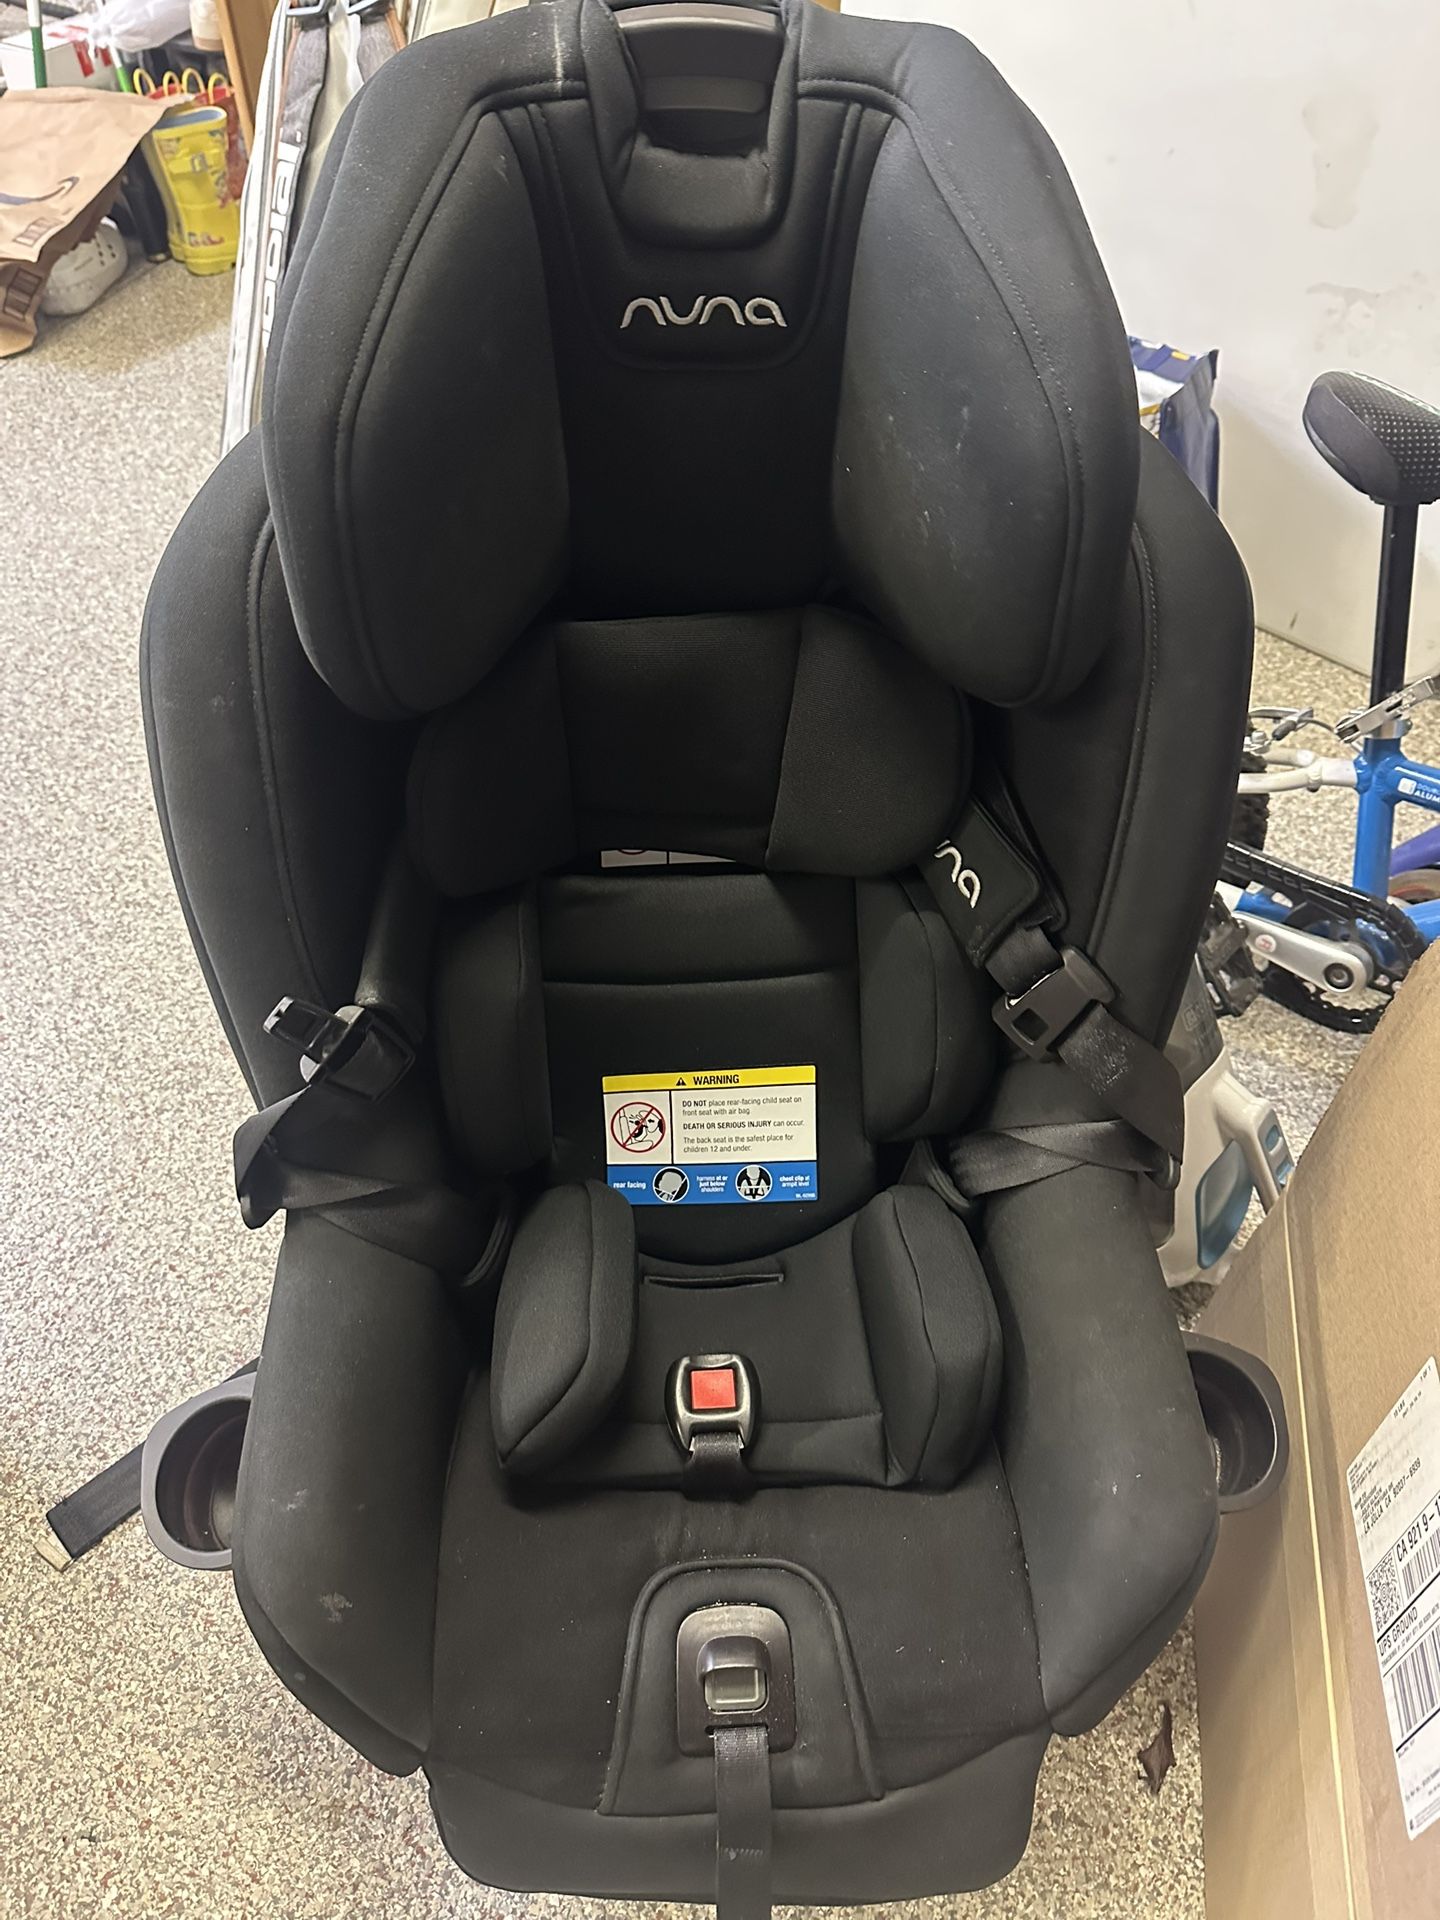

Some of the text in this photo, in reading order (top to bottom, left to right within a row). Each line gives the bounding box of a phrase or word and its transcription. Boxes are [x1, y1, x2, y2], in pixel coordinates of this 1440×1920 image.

[620, 296, 788, 328] nuna
[693, 1074, 739, 1085] WARNING
[694, 1099, 706, 1107] NOT
[727, 1098, 761, 1106] rear-facing
[762, 1096, 777, 1104] child
[683, 1122, 705, 1130] DEATH
[717, 1121, 746, 1129] SERIOUS
[748, 1120, 772, 1128] INJURY
[684, 1136, 695, 1144] The
[746, 1134, 765, 1142] safest
[766, 1134, 784, 1142] place
[785, 1133, 794, 1141] for
[613, 1180, 646, 1190] rear facing
[1385, 1494, 1392, 1509] CA
[1397, 1538, 1408, 1562] CA
[1379, 1606, 1418, 1657] UPS GROUND
